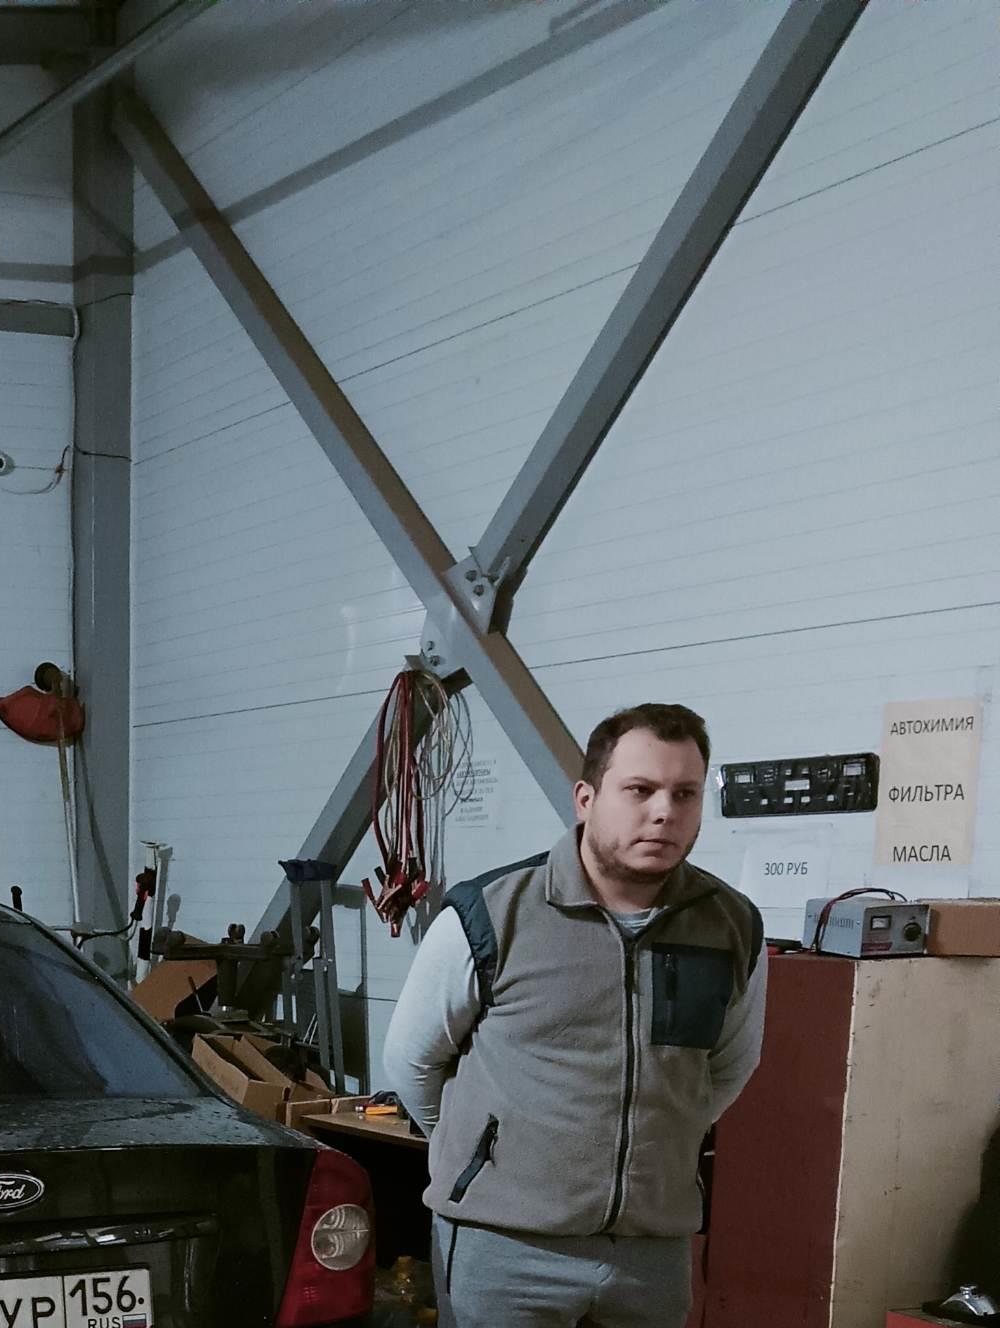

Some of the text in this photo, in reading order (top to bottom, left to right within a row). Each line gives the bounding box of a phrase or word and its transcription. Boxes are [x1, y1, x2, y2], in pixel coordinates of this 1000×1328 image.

[889, 715, 976, 736] АВТОХИМИЯ
[888, 784, 966, 803] ФИЛЬТРА
[892, 845, 952, 863] МАСЛА
[763, 861, 809, 876] 300 РУБ
[68, 1275, 138, 1317] 156
